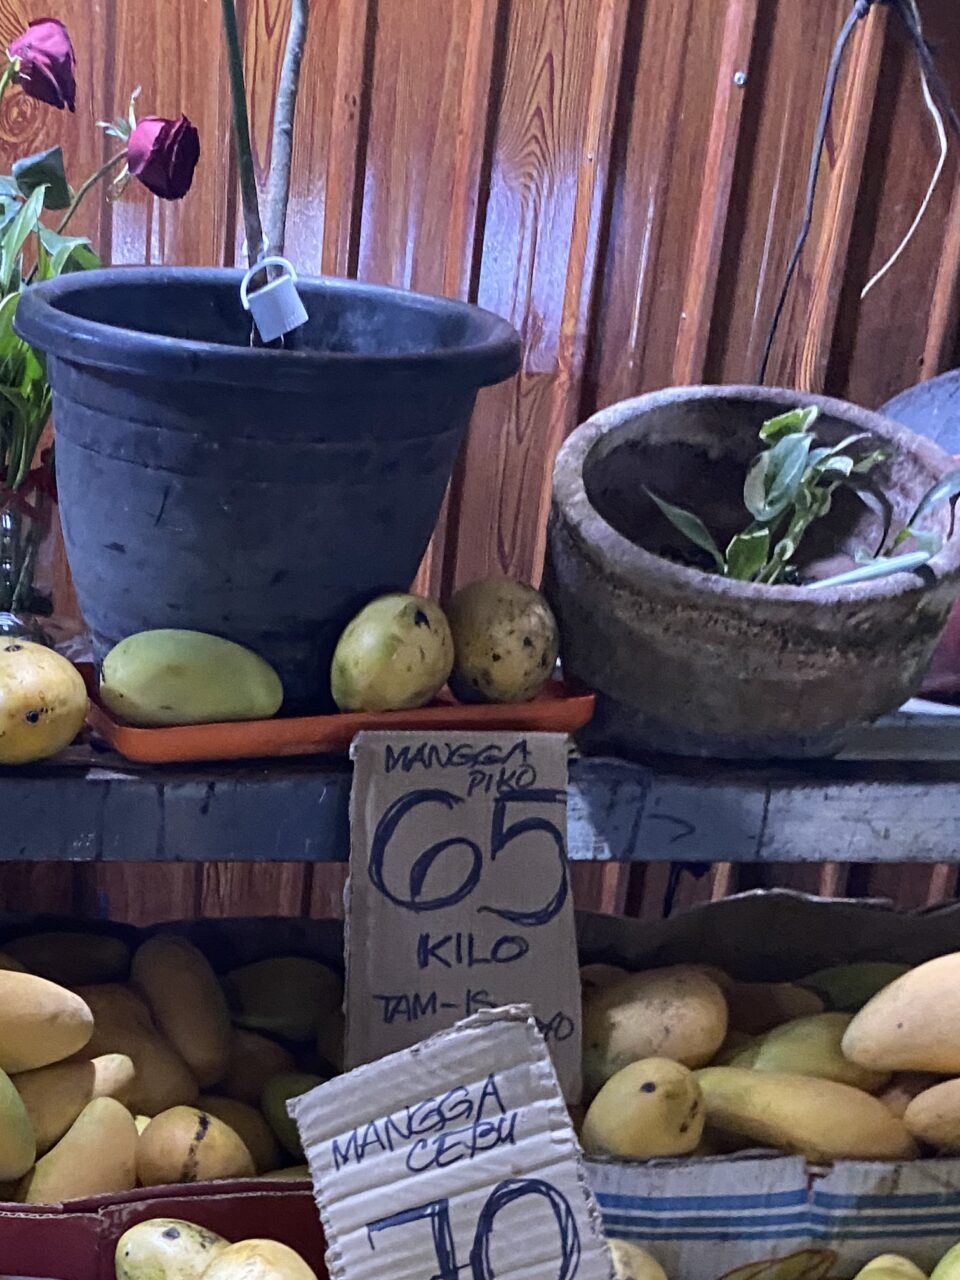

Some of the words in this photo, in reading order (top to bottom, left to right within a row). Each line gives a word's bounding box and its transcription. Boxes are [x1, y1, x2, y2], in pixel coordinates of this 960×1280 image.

[385, 739, 529, 772] MANGGA
[468, 765, 536, 796] PIKO
[368, 788, 569, 926] 65
[417, 932, 529, 968] KILO
[372, 988, 499, 1024] TAM-IS
[331, 1073, 506, 1171] MANGGA
[406, 1111, 517, 1173] CEBU
